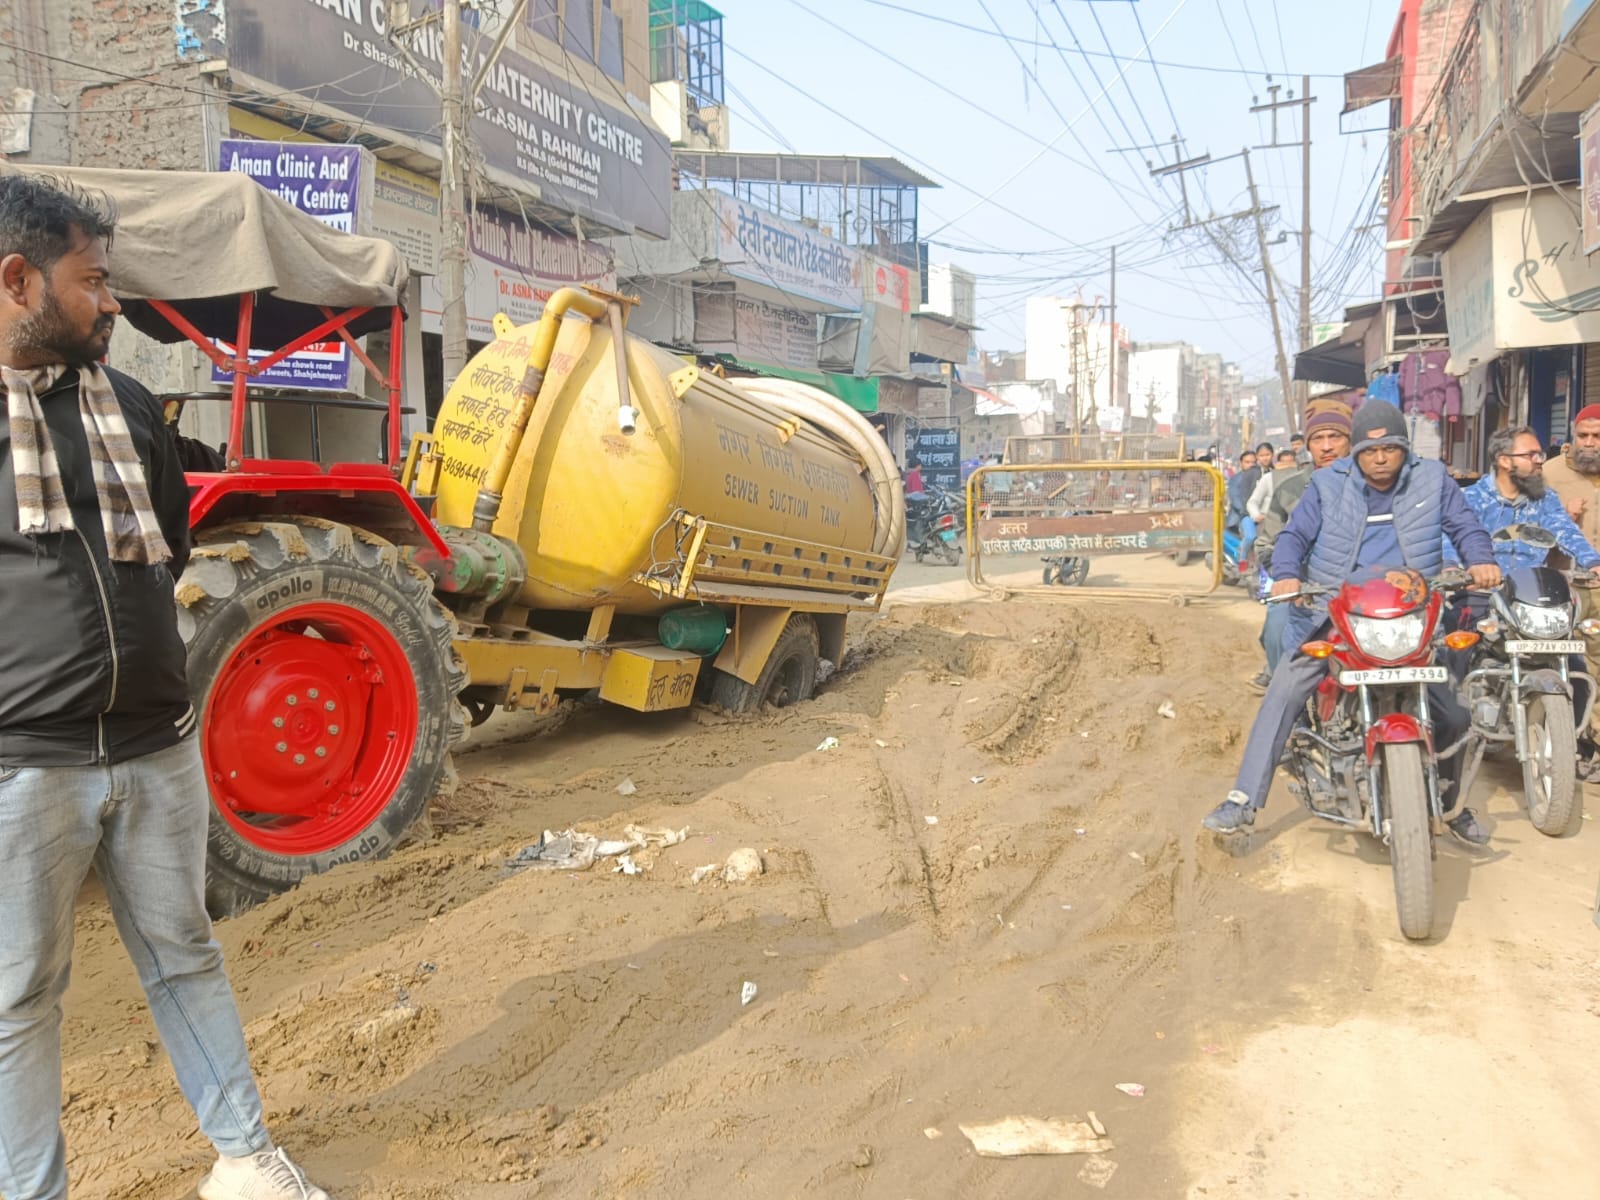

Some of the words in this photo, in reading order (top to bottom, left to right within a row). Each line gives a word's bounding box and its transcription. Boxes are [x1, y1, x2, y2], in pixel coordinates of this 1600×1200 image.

[299, 0, 362, 25] AN
[479, 53, 583, 136] MATERNITY
[587, 112, 643, 166] CENTRE
[230, 151, 271, 177] Aman
[276, 151, 315, 178] Clinic
[319, 155, 348, 181] And
[541, 128, 601, 173] RAHMAN
[303, 185, 348, 211] Centre
[472, 208, 508, 261] Clinic
[509, 221, 531, 269] And
[532, 229, 578, 281] Maternity
[738, 204, 761, 256] देवी
[762, 223, 797, 268] दयाल
[500, 279, 510, 296] Dr.
[512, 282, 531, 299] ASNA
[293, 369, 342, 382] Shahjahanpur
[315, 362, 333, 370] road
[470, 364, 500, 395] सीवर
[456, 395, 493, 425] सफाई
[486, 399, 512, 428] हेतु
[724, 473, 759, 505] SEWER
[768, 488, 809, 519] SUCTION
[819, 505, 841, 528] TANK
[982, 538, 1011, 554] पुलिस
[1032, 534, 1067, 552] आपकी
[1069, 533, 1094, 550] सेवा
[1137, 530, 1148, 549] है
[257, 576, 313, 610] apollo
